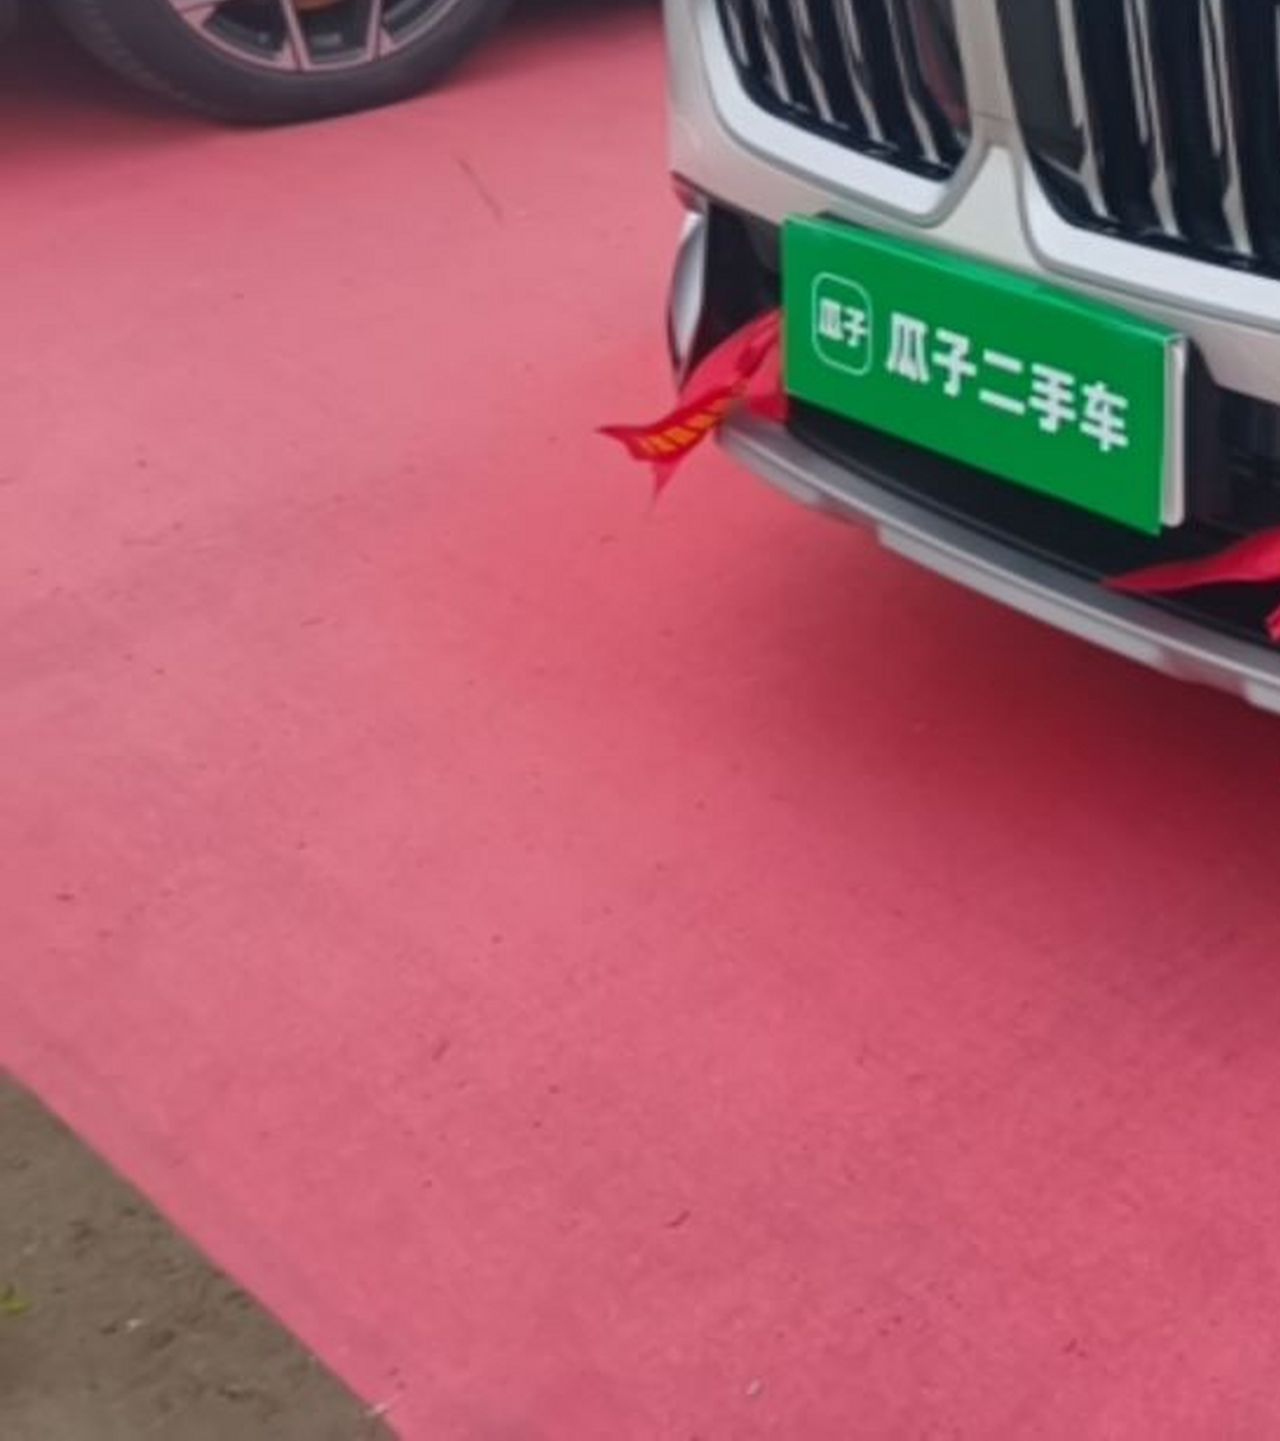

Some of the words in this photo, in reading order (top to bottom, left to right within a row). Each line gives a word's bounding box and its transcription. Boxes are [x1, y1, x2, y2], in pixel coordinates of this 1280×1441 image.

[817, 297, 867, 347] 瓜子
[886, 311, 1129, 452] 瓜子二手车
